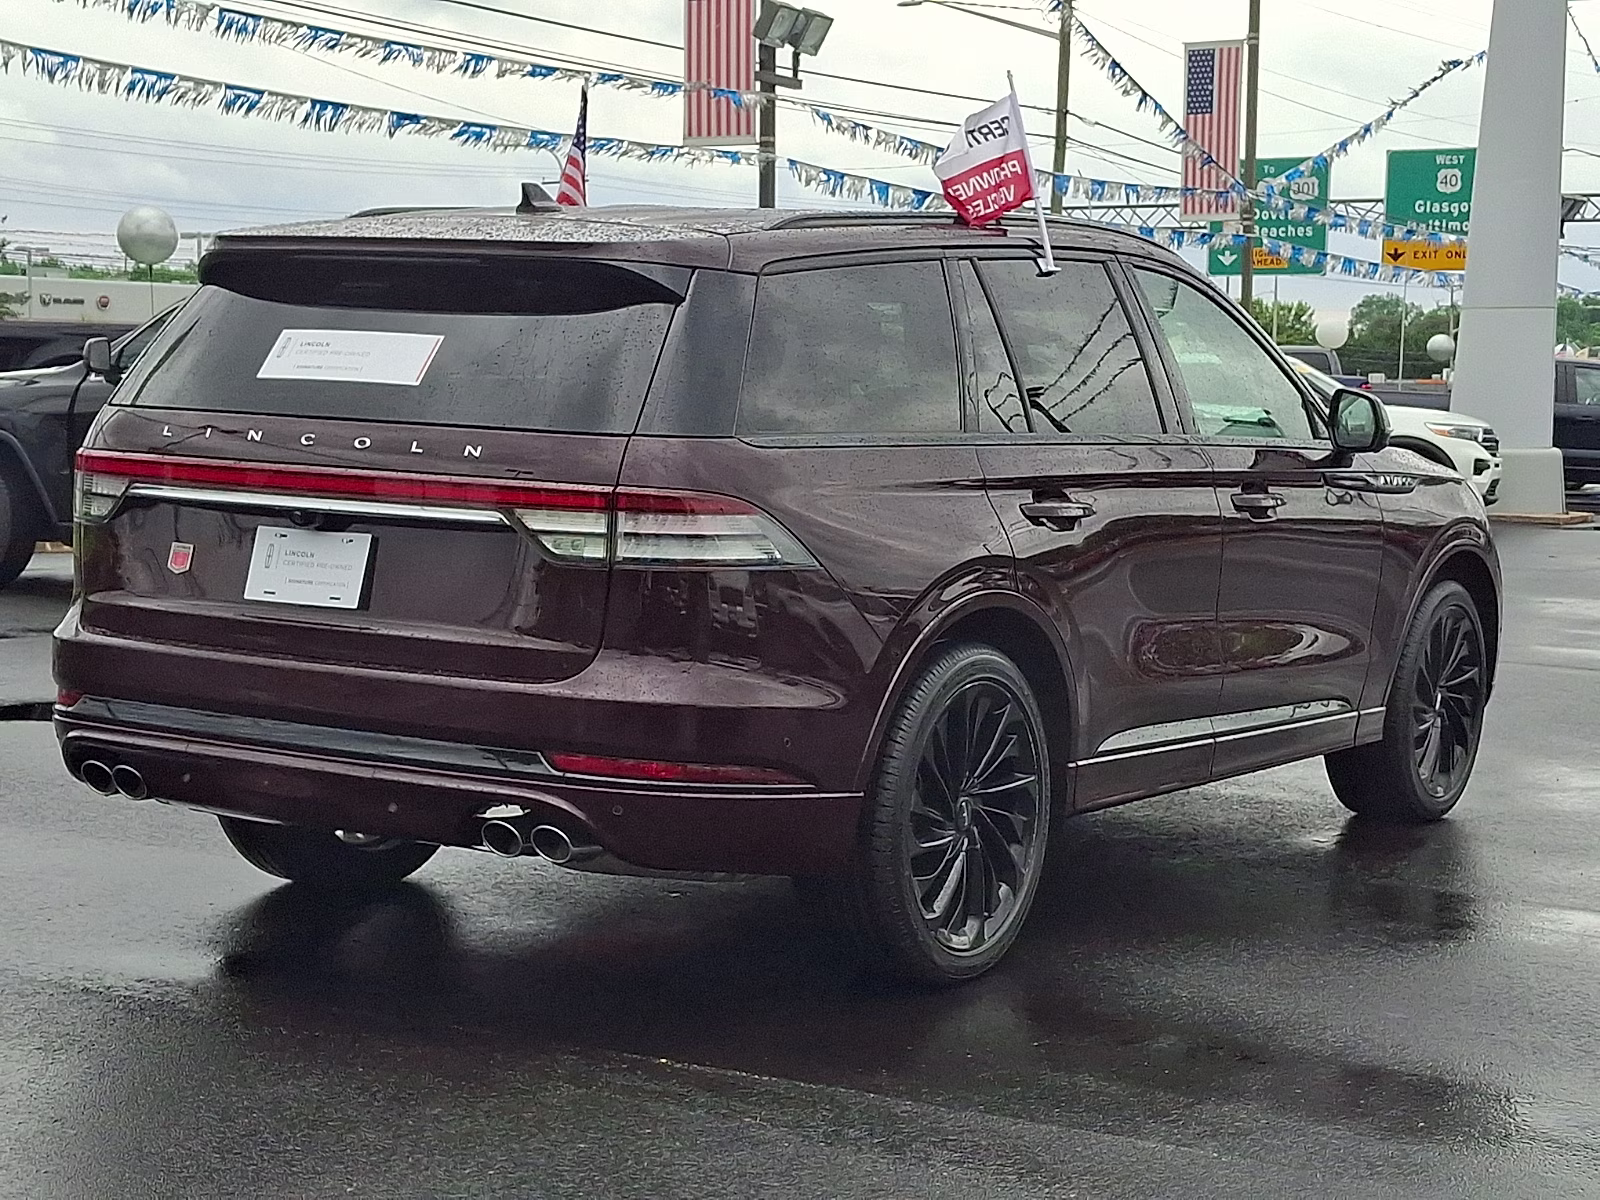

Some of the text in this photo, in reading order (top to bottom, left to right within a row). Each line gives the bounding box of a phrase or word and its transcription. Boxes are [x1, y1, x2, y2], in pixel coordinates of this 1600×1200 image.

[1436, 155, 1465, 165] WEST
[1264, 165, 1275, 174] To
[1439, 174, 1458, 187] 40
[1293, 181, 1315, 196] 301
[1414, 200, 1471, 217] Glasgo
[1413, 250, 1467, 259] EXIT ONL
[1252, 257, 1282, 267] HEAD
[162, 424, 482, 458] LINCOLN
[284, 549, 315, 558] LINCOLN
[282, 559, 353, 571] CERTIFIED PRE-OWNED
